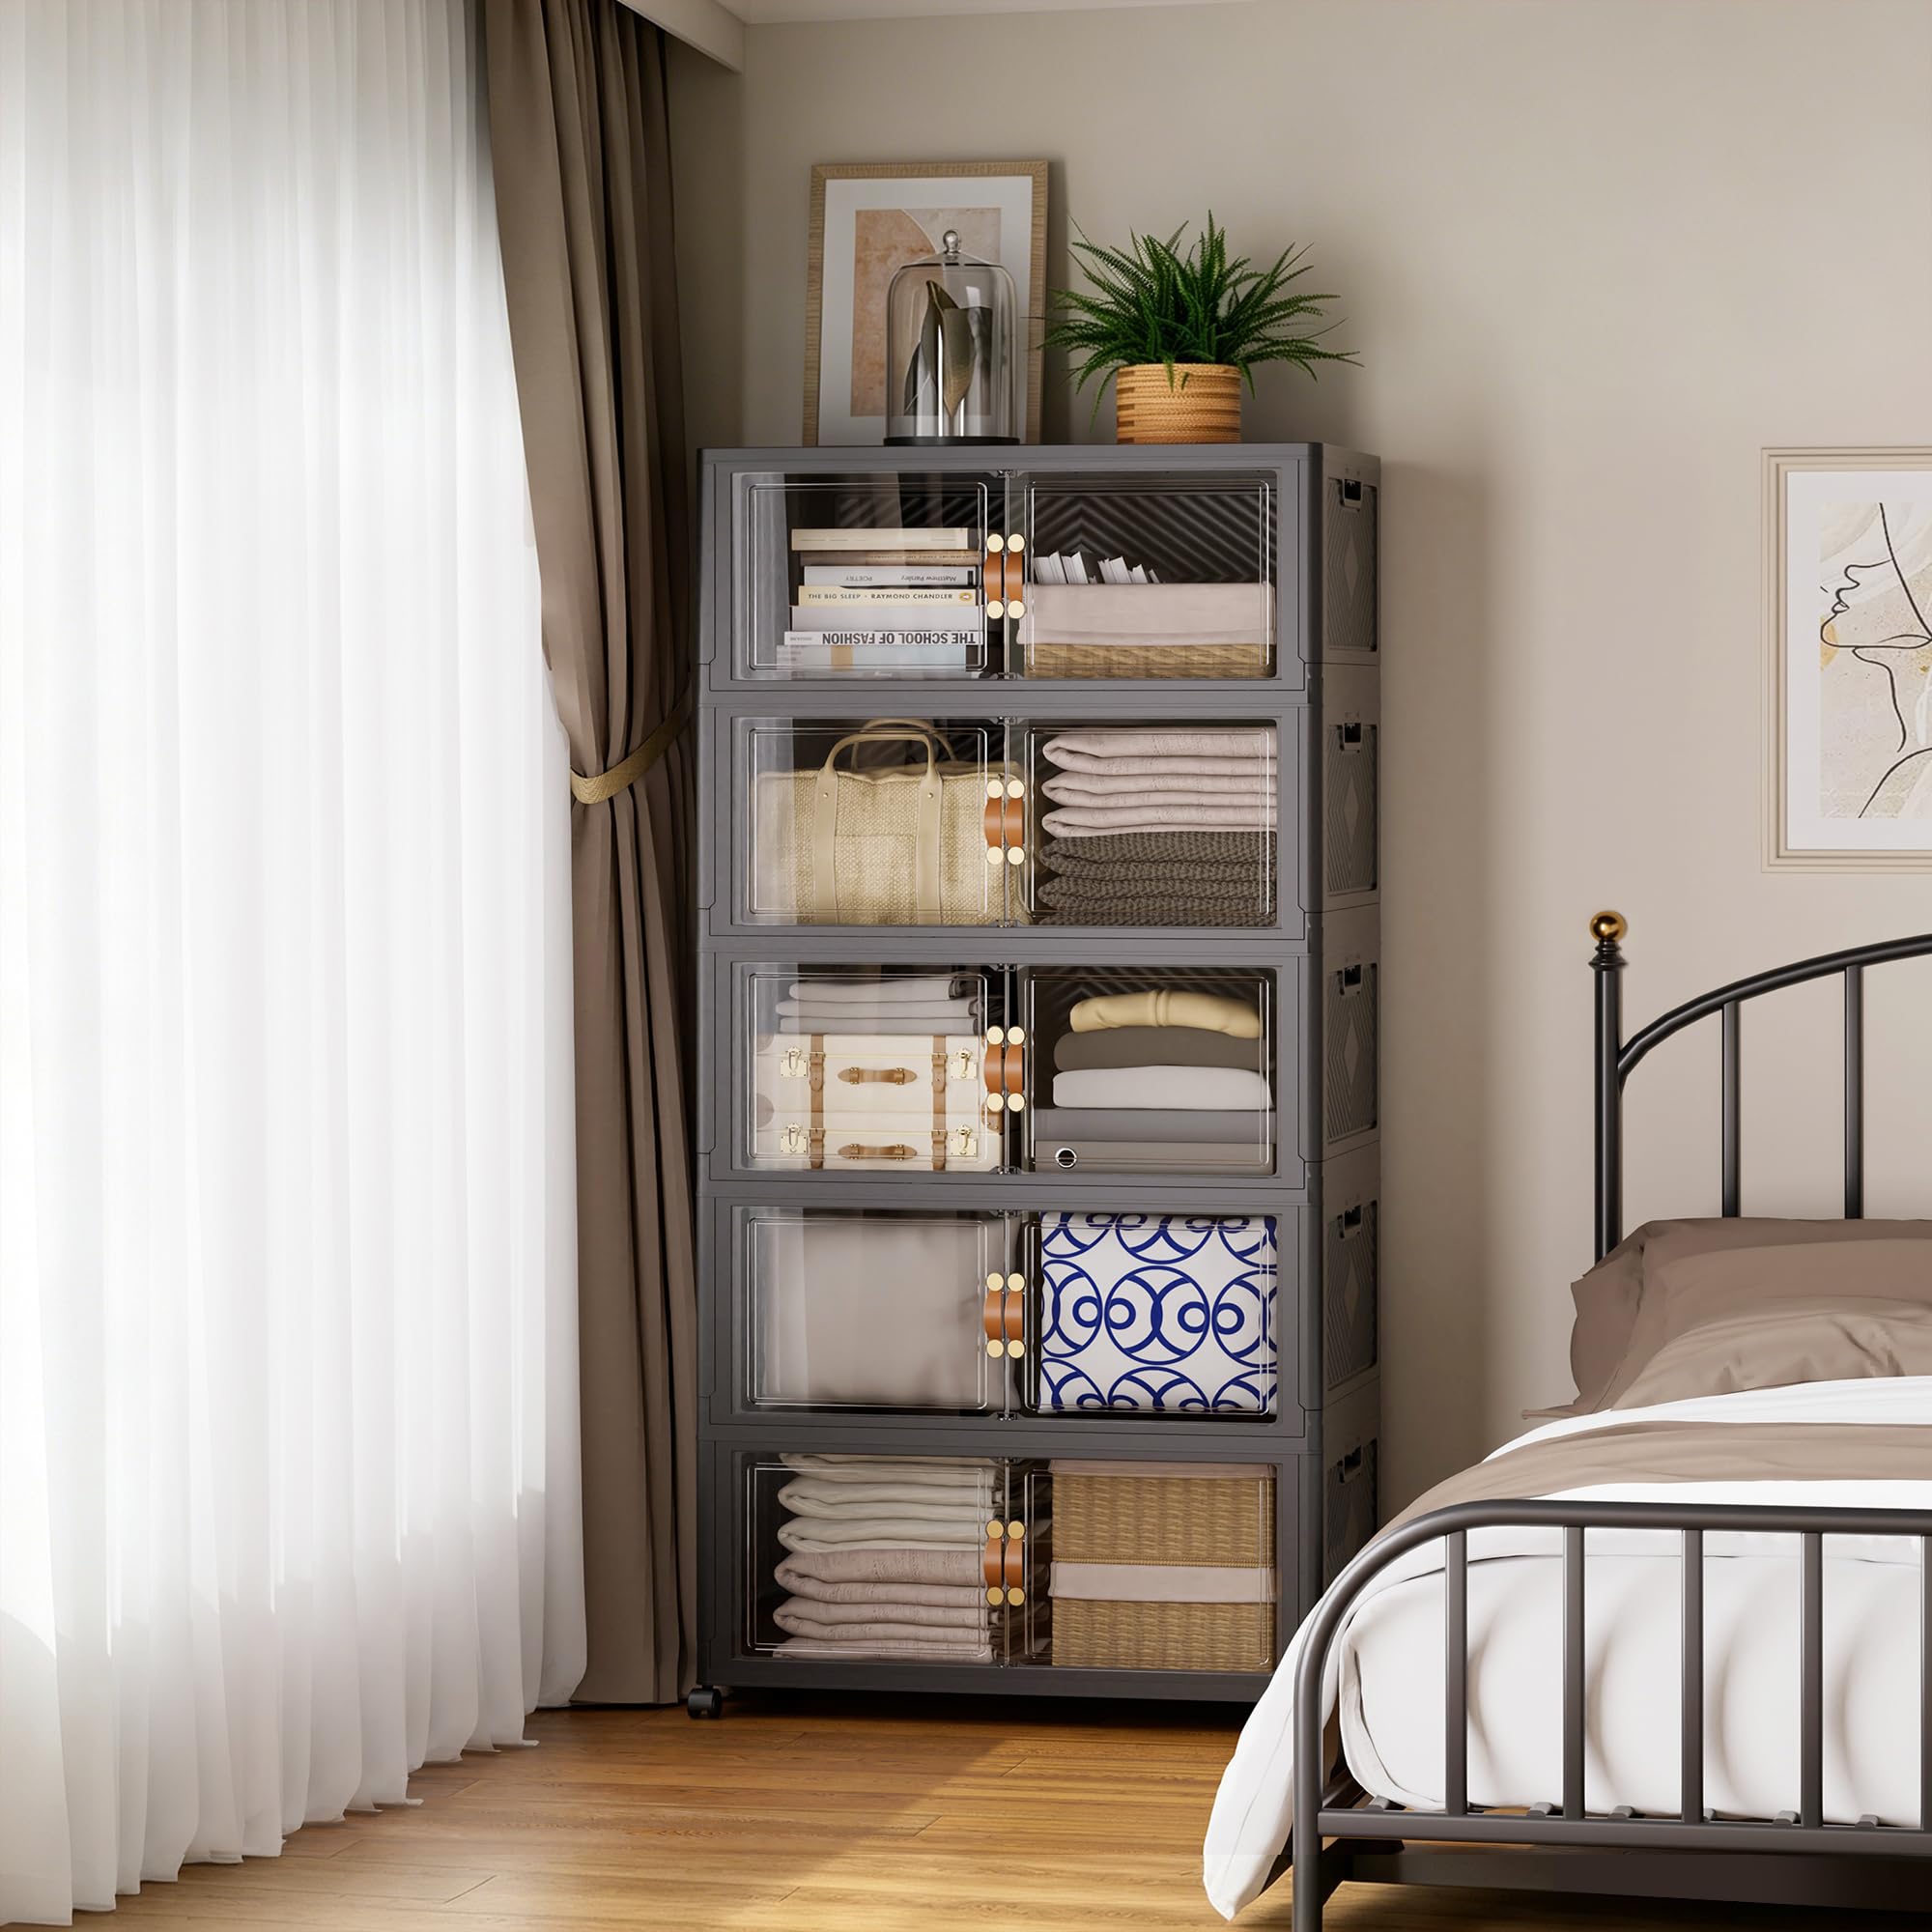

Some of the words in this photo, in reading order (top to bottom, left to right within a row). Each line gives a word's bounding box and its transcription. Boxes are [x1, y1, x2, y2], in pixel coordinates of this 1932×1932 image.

[822, 633, 875, 644] FASHION
[878, 633, 895, 644] OF
[899, 633, 949, 644] SCHOOL
[951, 633, 976, 644] THE
